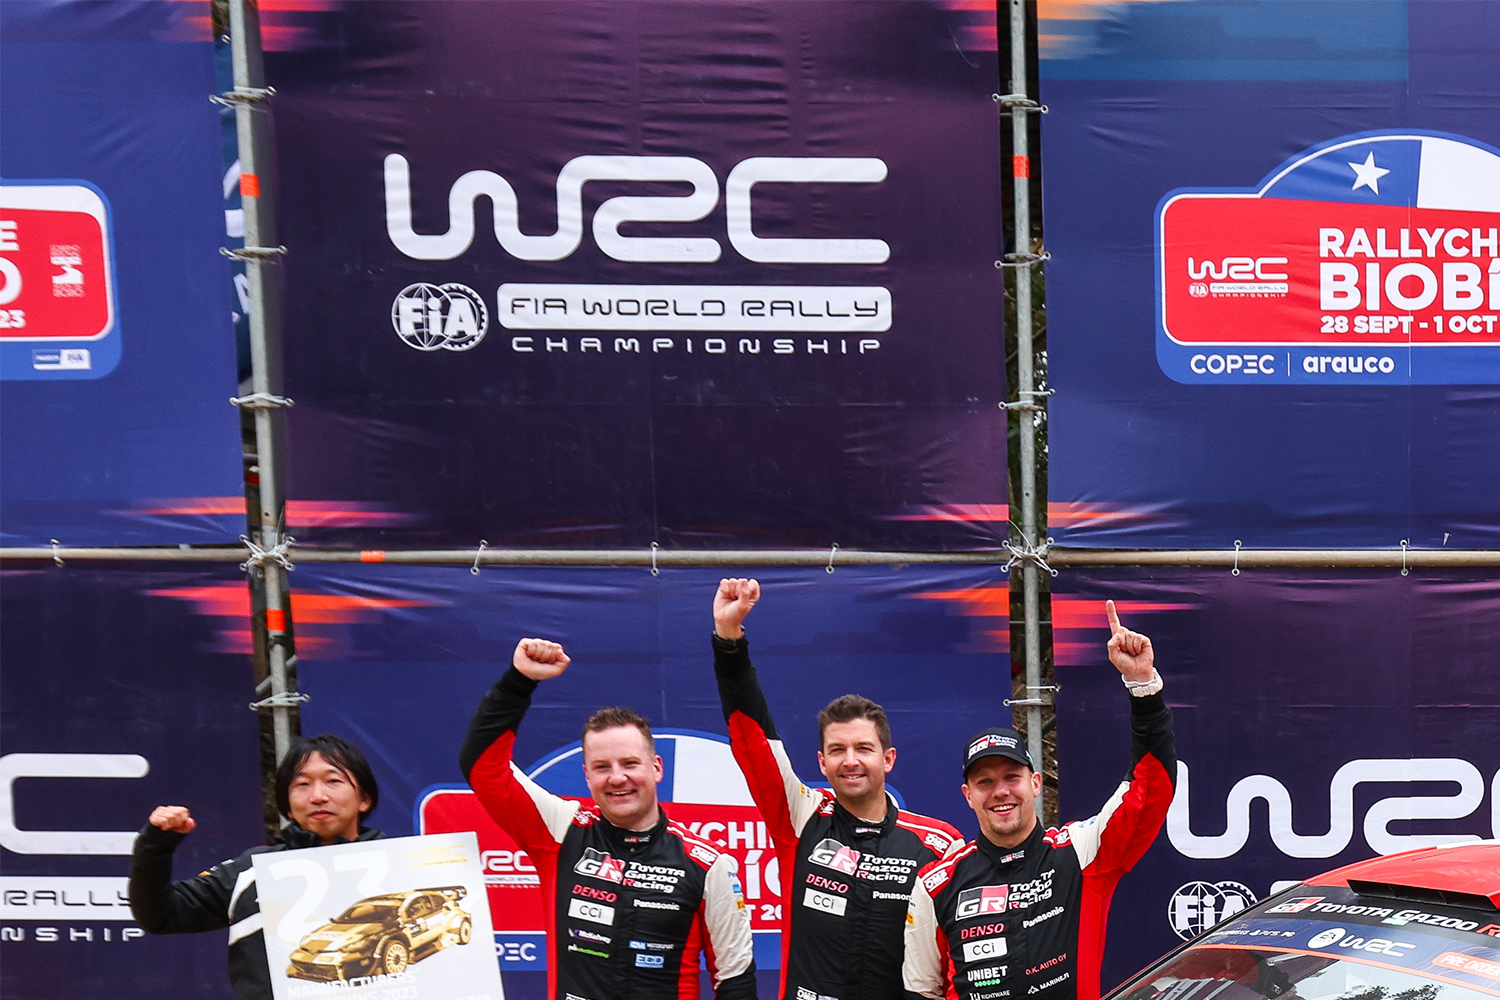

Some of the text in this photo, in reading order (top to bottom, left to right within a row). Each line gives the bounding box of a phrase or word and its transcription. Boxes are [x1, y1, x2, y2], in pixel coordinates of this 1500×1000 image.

[384, 153, 890, 264] WRC
[1187, 257, 1288, 280] WRC
[511, 298, 879, 317] FIA WORLD RALLY
[1320, 316, 1348, 333] 28
[1353, 316, 1411, 333] SEPT
[1432, 316, 1444, 333] 1
[1449, 316, 1497, 333] OCT
[512, 336, 881, 354] CHAMPIONSHIP
[1190, 354, 1275, 374] COPEC
[1303, 355, 1394, 374] arauco
[812, 849, 857, 873] GR
[859, 862, 911, 874] GAZOO
[862, 853, 917, 868] TOYOTA
[625, 870, 678, 884] GAZOO
[629, 862, 685, 877] TOYOTA
[856, 870, 908, 884] Racing
[622, 878, 675, 893] Racing
[806, 873, 849, 893] DENSO
[572, 884, 618, 903] DENSO
[813, 895, 834, 909] CCi
[633, 899, 680, 911] Panasonic
[958, 896, 1005, 917] GR
[1022, 905, 1065, 928] Panasonic
[1313, 902, 1479, 932] TOYOTA GAZOO
[961, 923, 1005, 940] DENSO
[972, 943, 995, 956] CCi
[1339, 935, 1417, 957] WRC
[1040, 958, 1058, 971] AUTO
[1441, 954, 1464, 969] PRE
[967, 966, 1008, 982] UNIBET
